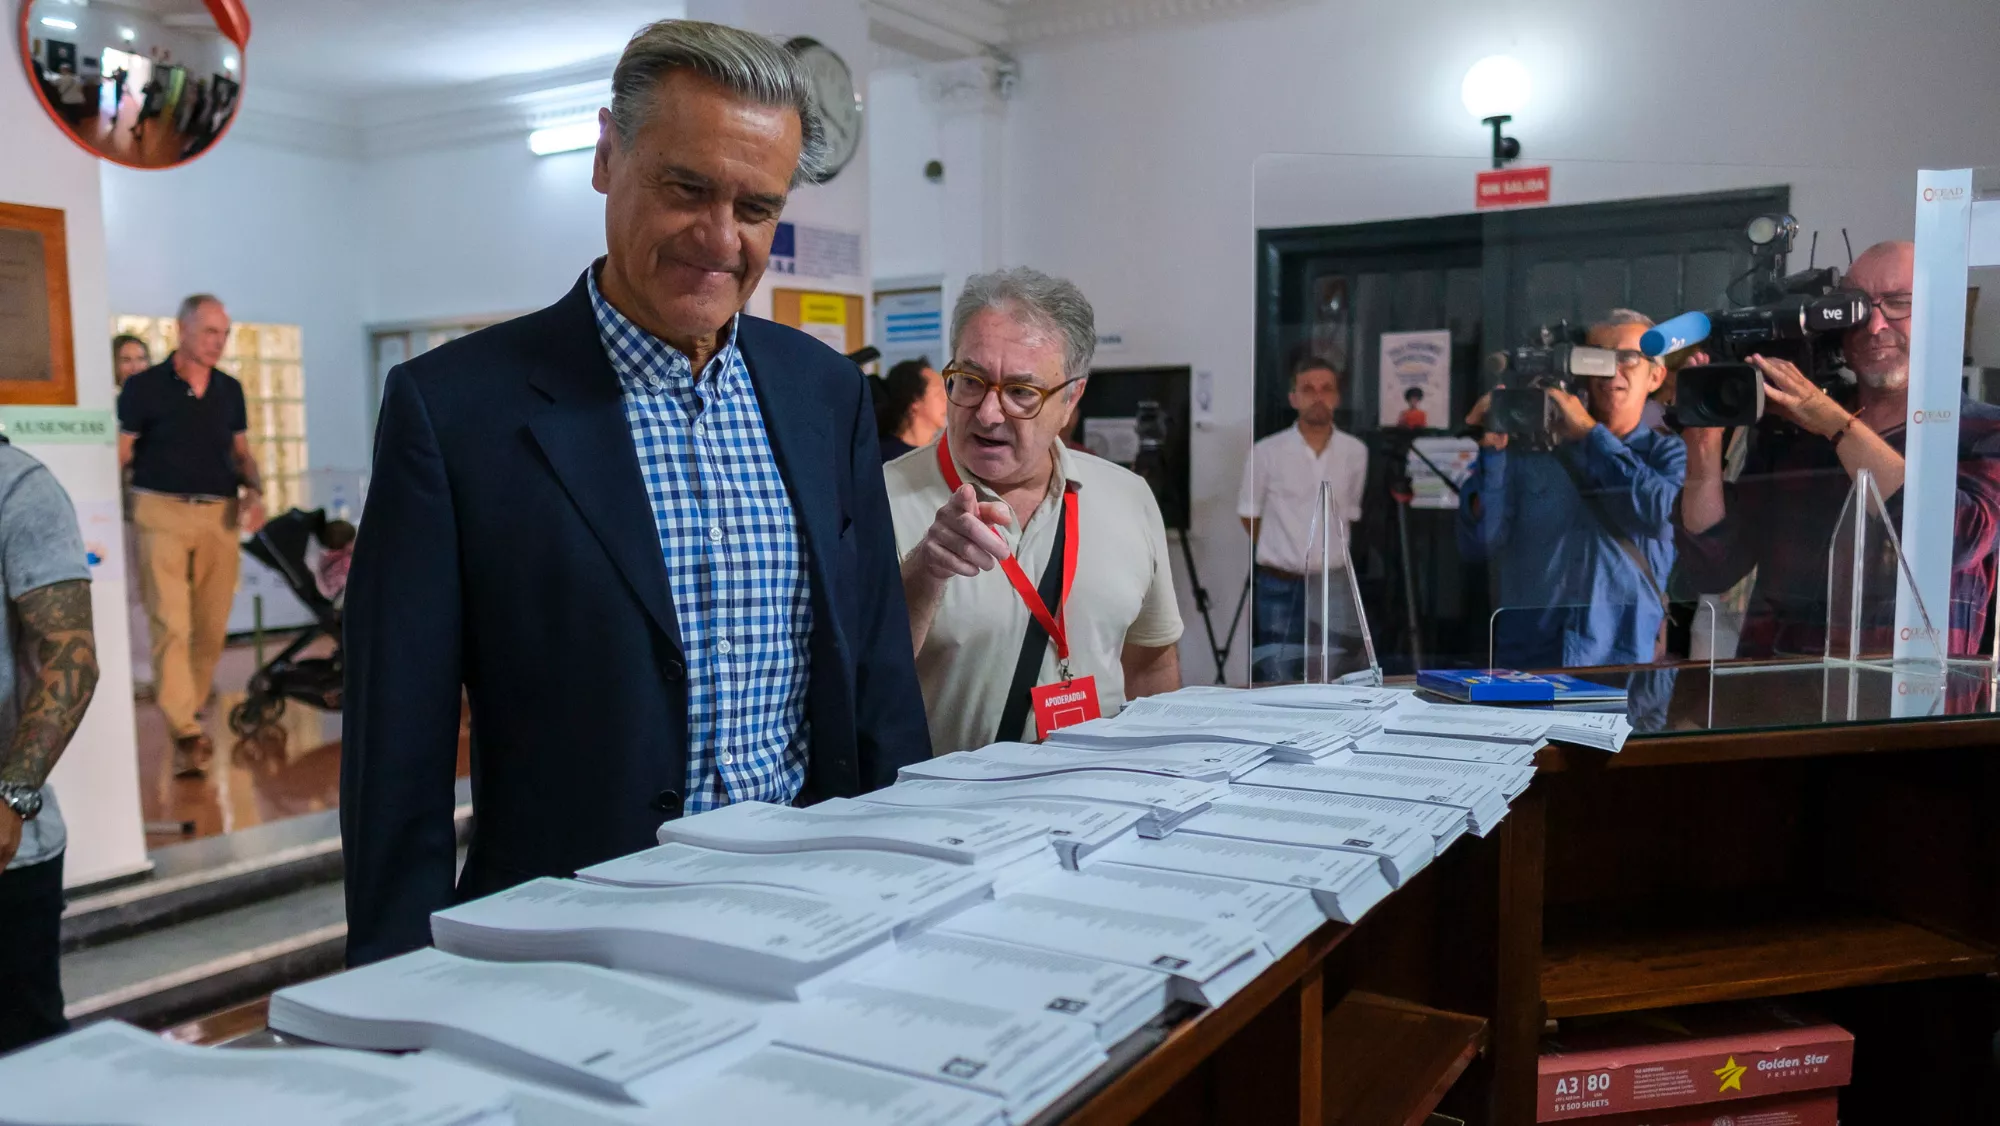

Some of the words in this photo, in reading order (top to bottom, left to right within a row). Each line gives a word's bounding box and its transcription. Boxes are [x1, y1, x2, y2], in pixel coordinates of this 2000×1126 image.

[1822, 308, 1843, 320] tve
[1045, 691, 1087, 708] APODERADO/A
[1757, 1057, 1800, 1071] Golden
[1804, 1054, 1830, 1065] Star
[1767, 1067, 1819, 1078] PREMIUM
[1555, 1076, 1579, 1095] A3
[1587, 1073, 1610, 1091] 80
[1582, 1099, 1609, 1109] SHEETS
